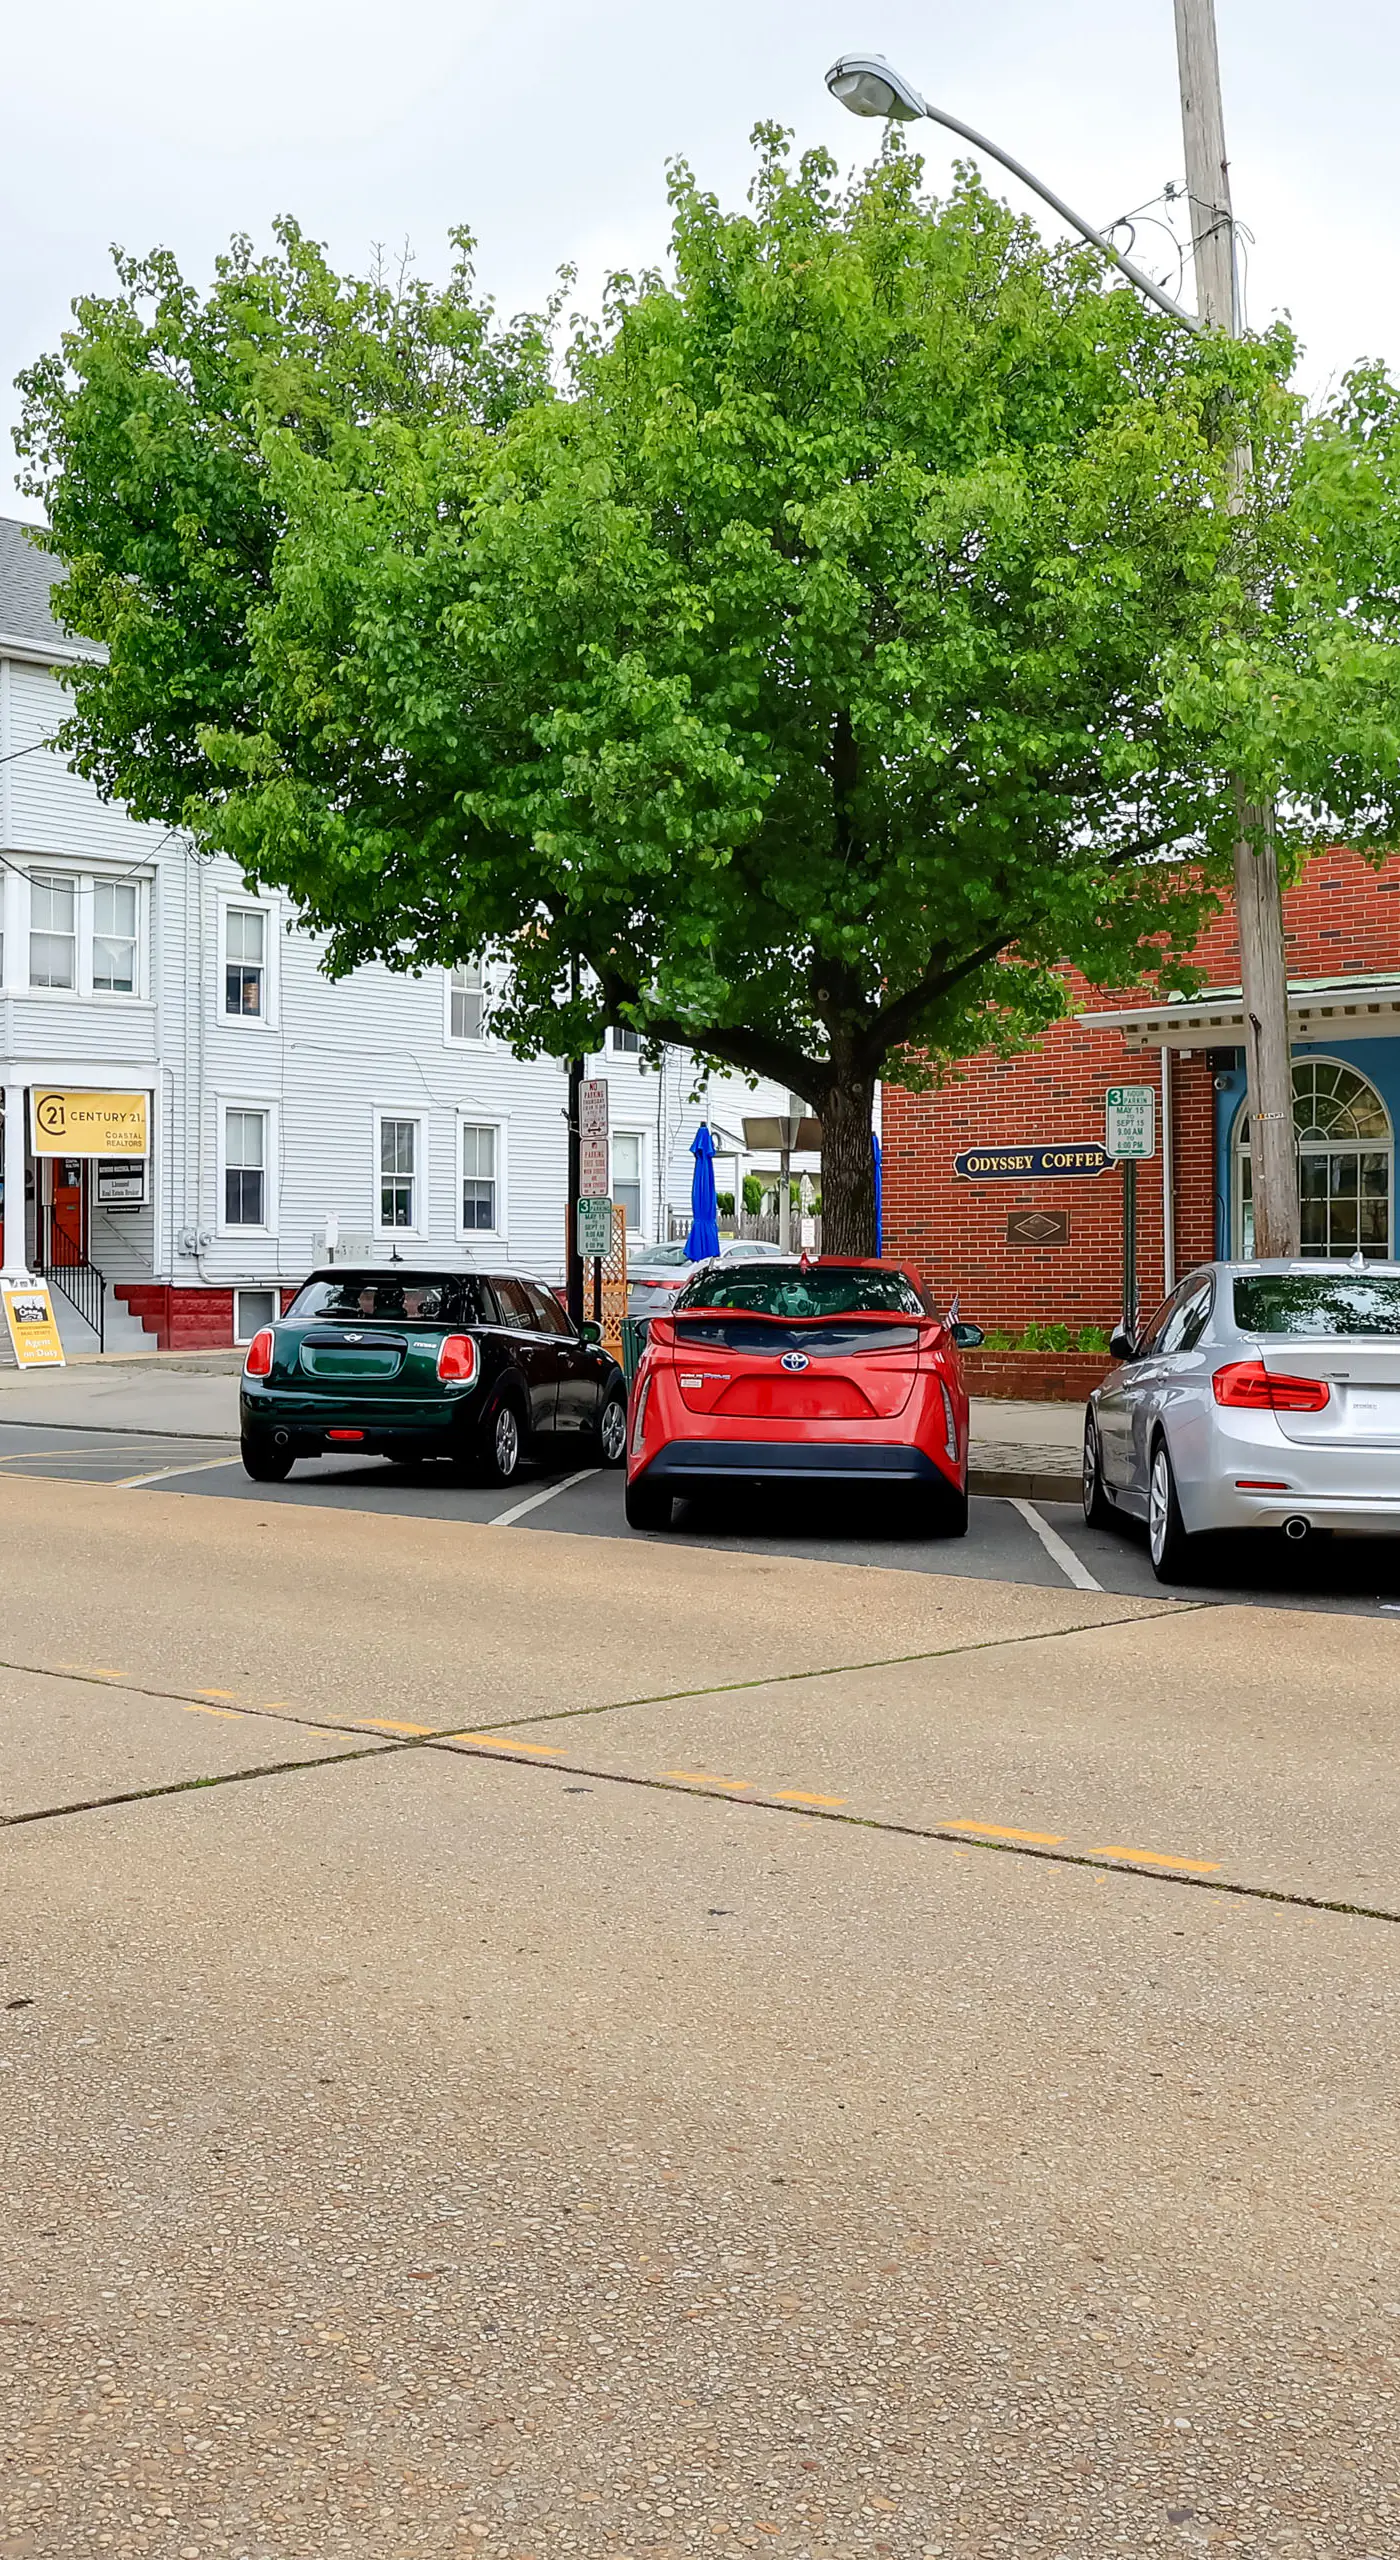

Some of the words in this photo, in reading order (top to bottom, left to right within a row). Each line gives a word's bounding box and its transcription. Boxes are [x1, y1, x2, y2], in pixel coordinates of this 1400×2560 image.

[590, 1082, 597, 1090] NO
[1111, 1090, 1121, 1104] 3
[70, 1111, 127, 1123] CENTURY
[105, 1131, 142, 1139] COASTAL
[967, 1155, 1034, 1172] ODYSSEY
[1041, 1152, 1104, 1168] COFFEE
[581, 1200, 588, 1211] 3
[36, 1349, 57, 1357] Duty
